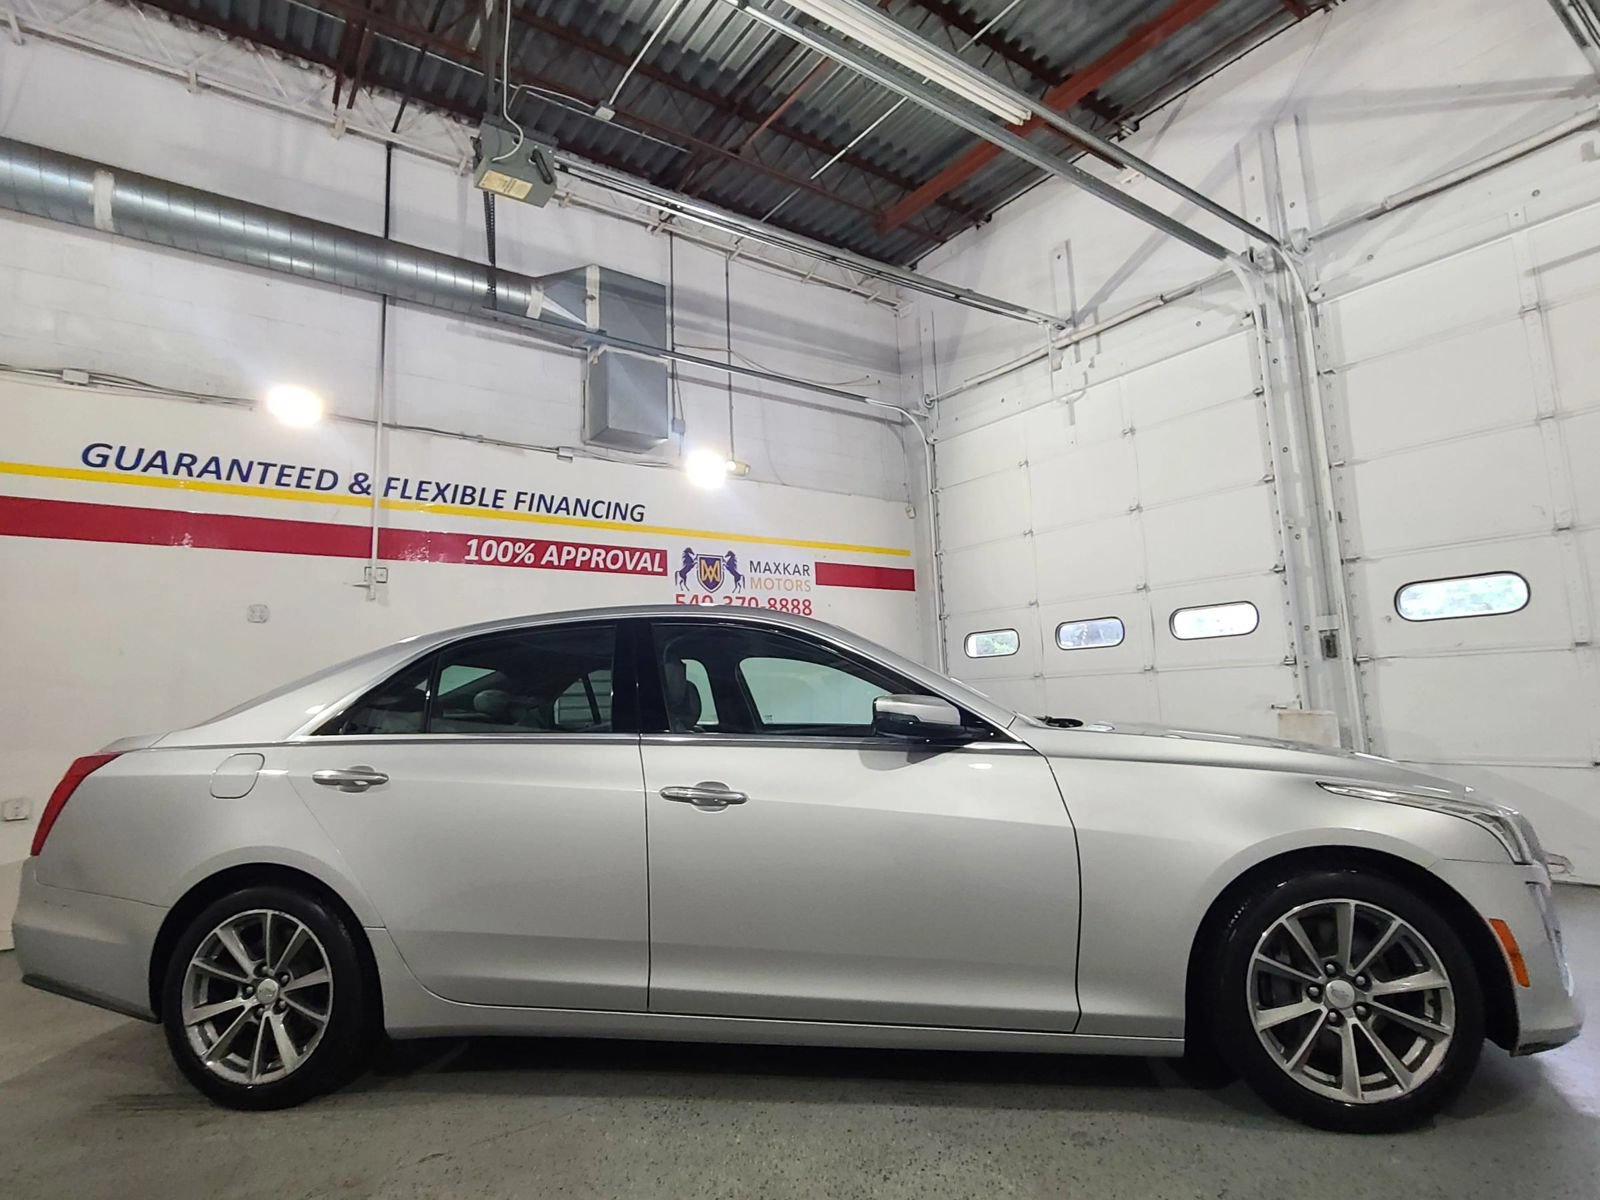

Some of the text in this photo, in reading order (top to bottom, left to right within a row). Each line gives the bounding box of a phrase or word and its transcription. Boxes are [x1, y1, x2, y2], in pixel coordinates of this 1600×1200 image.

[81, 442, 646, 522] GUARANTEED & FLEXIBLE FINANCING
[464, 538, 664, 572] 100% APPROVAL
[749, 560, 811, 577] MAXKAR
[750, 577, 812, 593] MOTORS
